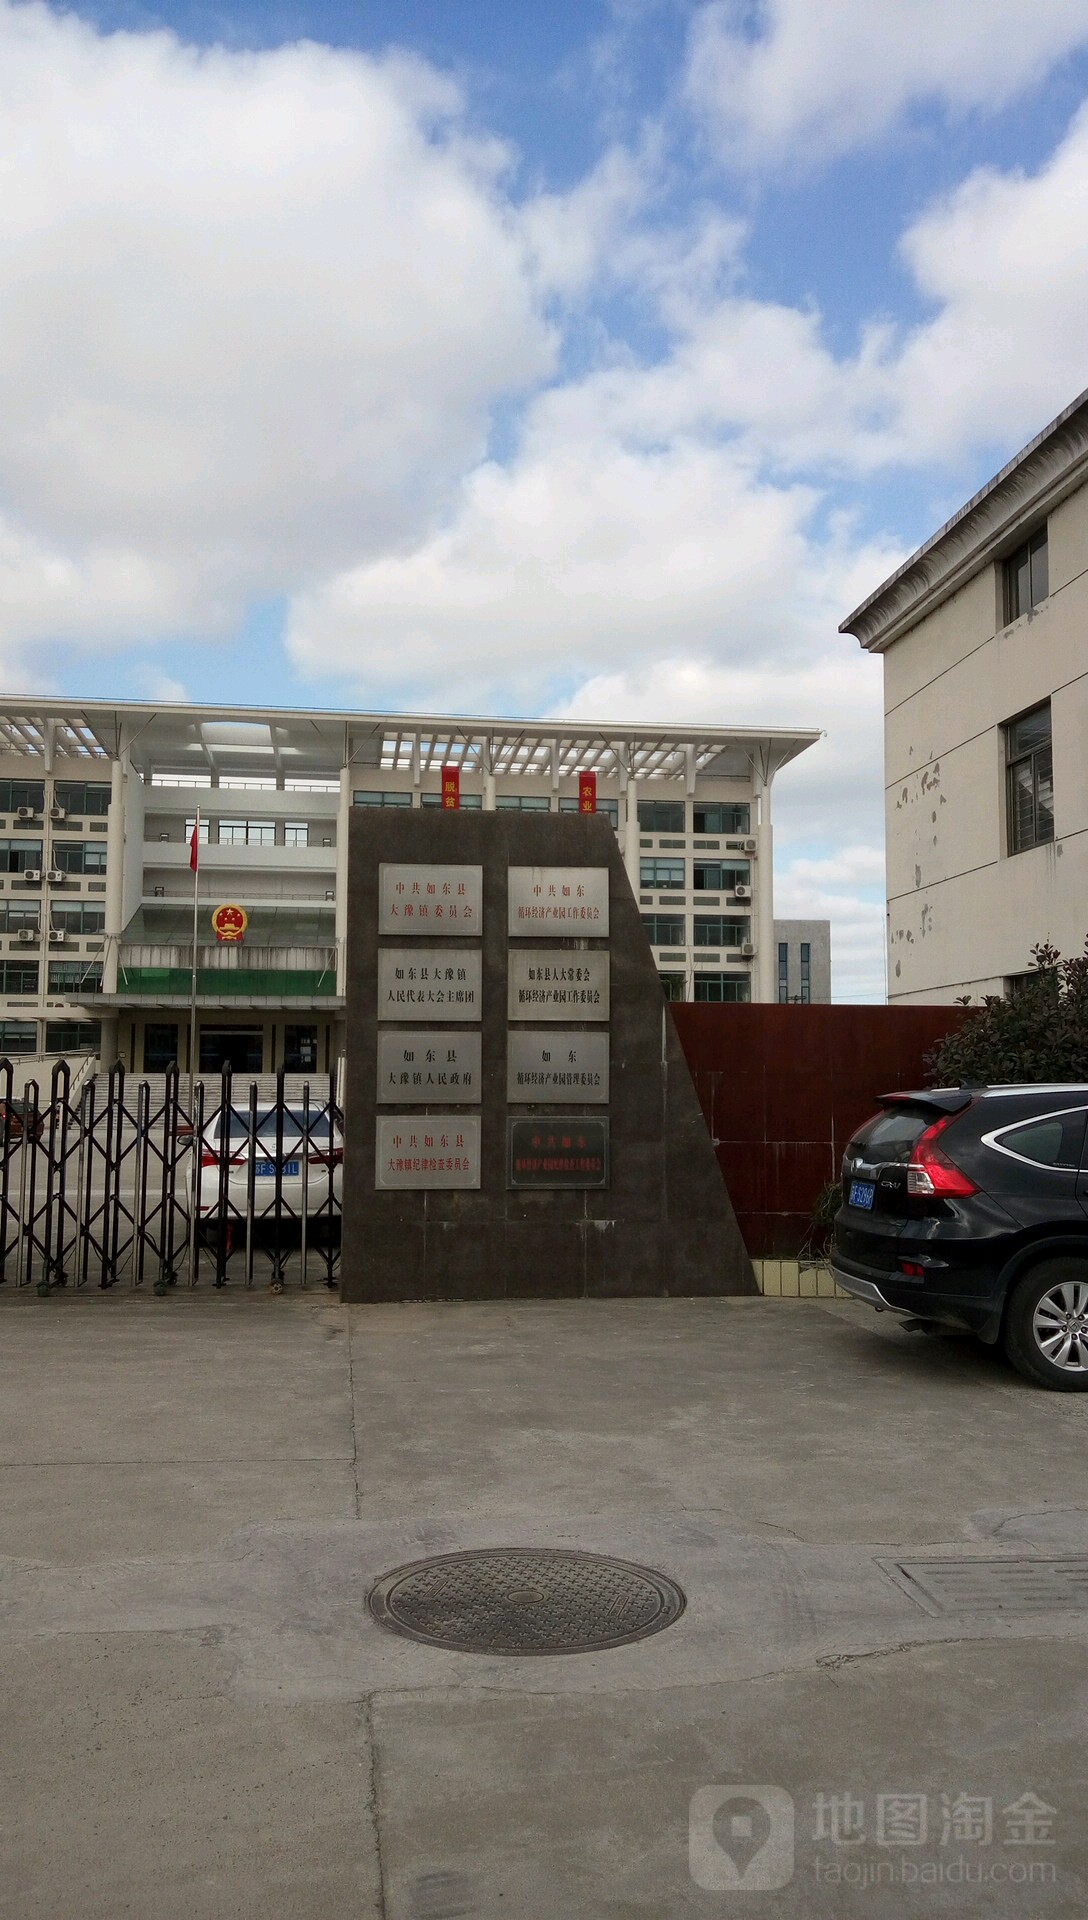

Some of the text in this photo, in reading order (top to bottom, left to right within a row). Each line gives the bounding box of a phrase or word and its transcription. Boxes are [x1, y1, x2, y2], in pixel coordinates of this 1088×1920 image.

[445, 781, 456, 808] 脱贫
[582, 786, 593, 811] 农业
[396, 882, 466, 895] 中共如东县
[533, 884, 585, 897] 中共如东
[390, 903, 473, 918] 大豫镇委员会
[518, 905, 600, 920] 循环经济产业园工作委员会
[395, 967, 467, 981] 如东县大豫镇
[528, 967, 591, 982] 如东县人大常委会
[387, 989, 475, 1004] 人民代表大会主席团
[518, 989, 600, 1004] 循环经济产业园工作委员会
[403, 1049, 457, 1063] 如东县
[541, 1049, 577, 1063] 如东
[388, 1071, 472, 1086] 大豫镇人民政府
[517, 1071, 601, 1086] 循环经济产业园管理委员会
[393, 1134, 465, 1148] 中共如东县
[387, 1157, 470, 1172] 大豫镇纪律检查委员会
